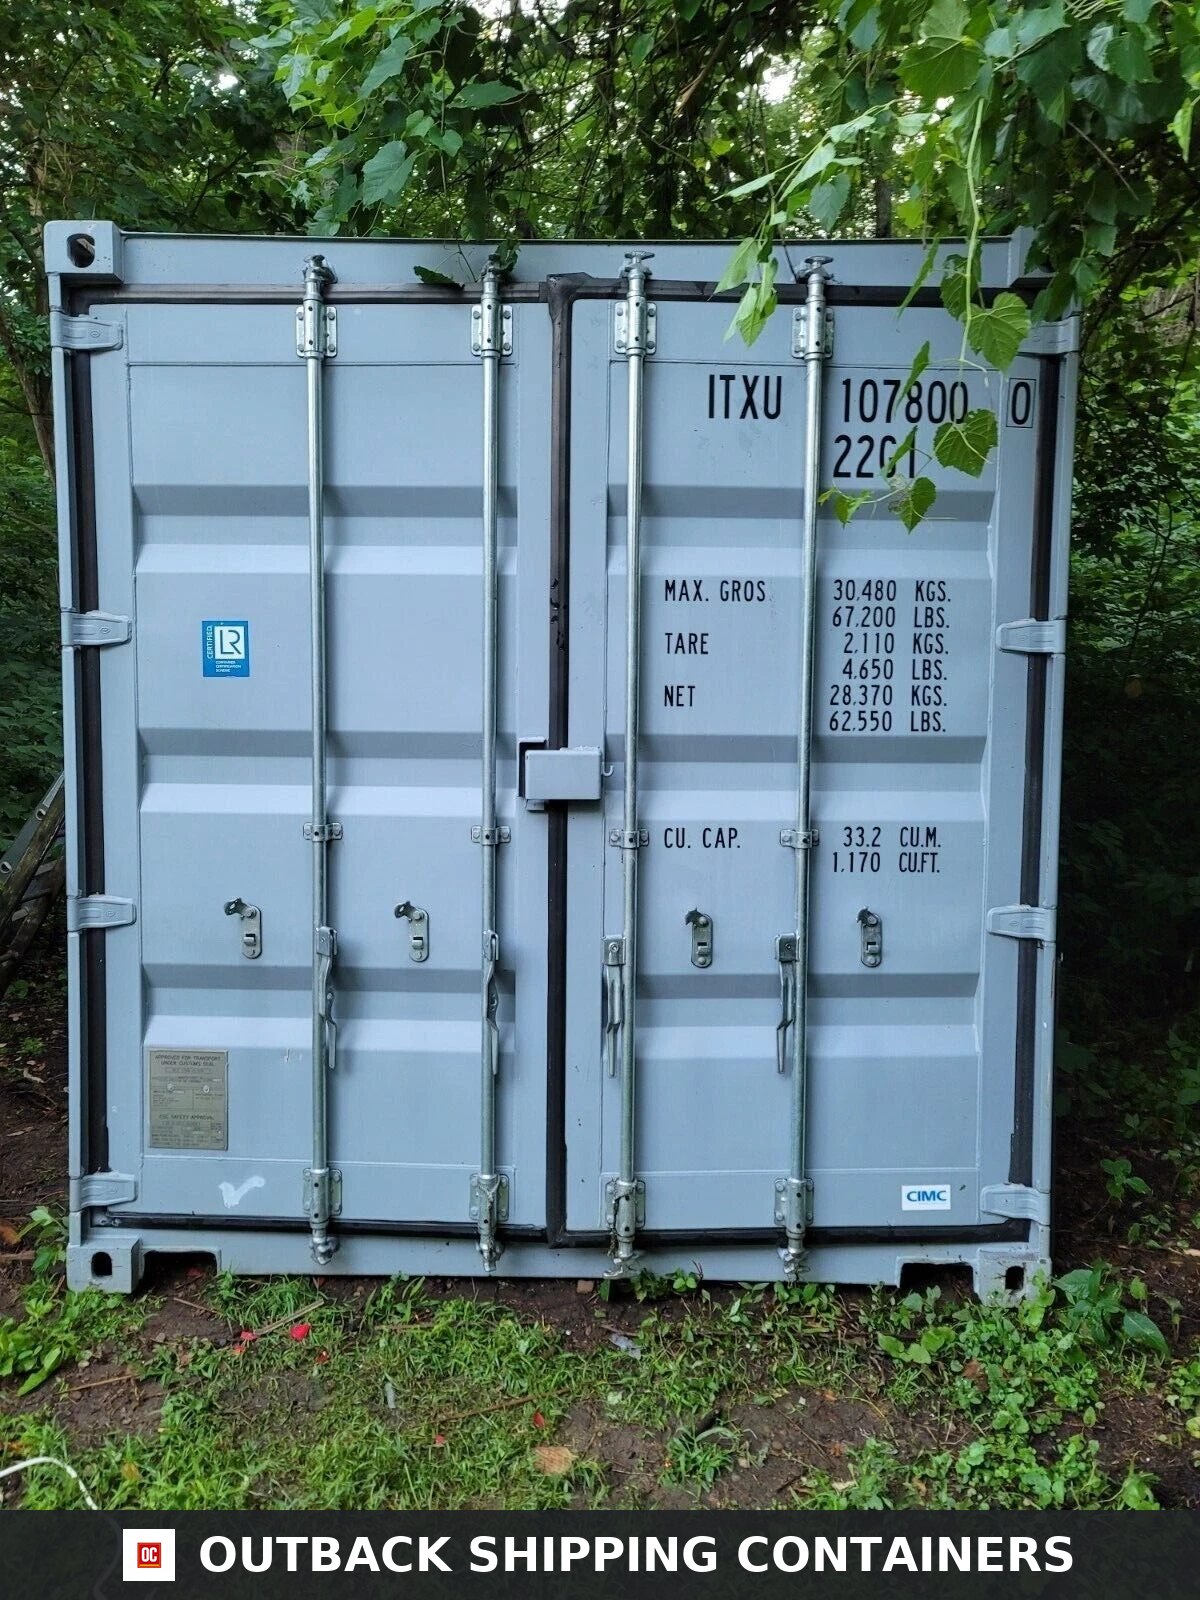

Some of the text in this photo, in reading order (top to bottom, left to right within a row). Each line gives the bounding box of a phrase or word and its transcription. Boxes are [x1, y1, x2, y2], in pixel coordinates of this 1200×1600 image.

[708, 374, 1032, 425] ITXU 107800 0
[664, 579, 709, 602] MAX.
[833, 579, 897, 602] 30,480
[914, 580, 951, 602] KGS.
[832, 606, 950, 629] 67,200 LBS.
[219, 629, 242, 655] LR
[664, 632, 949, 655] TARE 2,110 KGS.
[842, 658, 948, 681] 4,650 LBS.
[664, 684, 947, 707] NET 28,370 KGS.
[829, 710, 946, 732] 62,550 LBS.
[663, 826, 942, 849] CU. CAP. 33.2 CU.M.
[832, 851, 940, 874] 1,170 CU.FT.
[906, 1190, 947, 1202] CIMC
